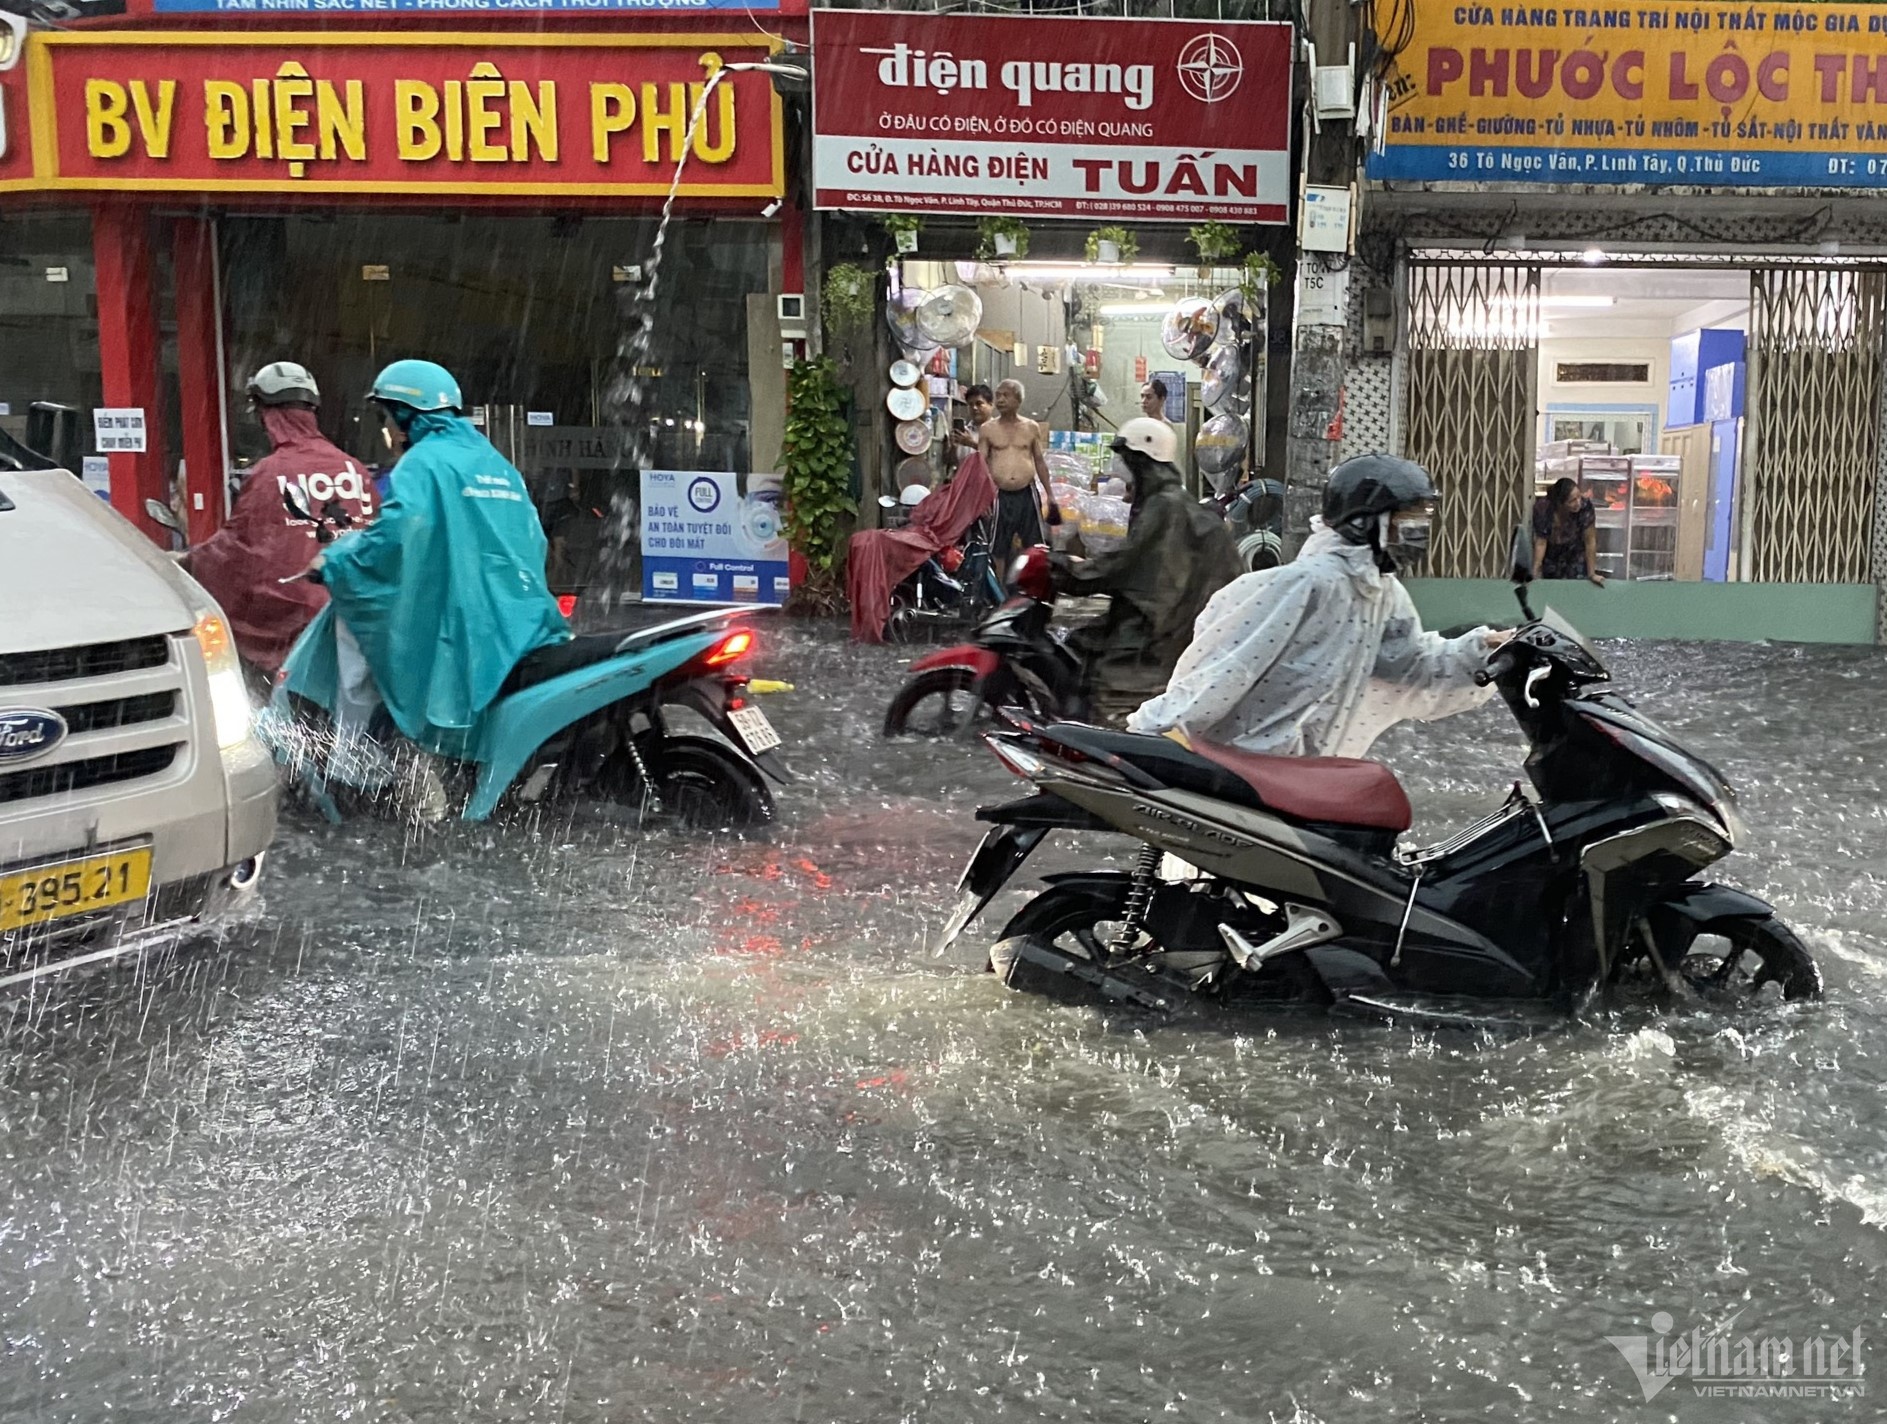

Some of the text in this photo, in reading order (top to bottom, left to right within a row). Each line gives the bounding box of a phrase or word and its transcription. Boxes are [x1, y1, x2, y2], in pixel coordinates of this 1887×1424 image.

[1454, 3, 1494, 26] CỬA
[1501, 5, 1558, 28] HÀNG
[1563, 9, 1631, 28] TRANG
[1637, 8, 1669, 29] TRÍ
[1675, 8, 1710, 34] NỘI
[1717, 6, 1767, 32] THẤT
[1773, 10, 1818, 35] MỘC
[1825, 14, 1860, 32] GIA
[860, 42, 1155, 110] điện quang
[1426, 36, 1645, 100] PHƯỚC
[1669, 39, 1790, 119] LỘC
[84, 79, 177, 159] BV
[204, 61, 367, 178] ĐIỆN
[395, 61, 558, 163] BIÊN
[590, 52, 736, 164] PHỦ
[894, 114, 927, 131] ĐÂU
[929, 115, 951, 132] CÓ
[954, 115, 992, 135] ĐIỆN,
[1009, 118, 1033, 134] ĐÓ
[1036, 118, 1057, 135] CÓ
[1060, 119, 1096, 138] ĐIỆN
[1098, 121, 1154, 138] QUANG
[1808, 116, 1850, 140] THẤT
[847, 143, 1259, 198] CỬA HÀNG ĐIỆN TUẤN
[1448, 152, 1469, 169] 36
[1476, 152, 1494, 169] Tô
[1501, 153, 1542, 174] Ngọc
[1549, 153, 1582, 172] Vân,
[1585, 154, 1598, 171] P.
[1602, 154, 1637, 171] Linh
[1643, 154, 1672, 173] Tây,
[1730, 154, 1760, 173] Đức
[1828, 158, 1856, 175] ĐT:
[695, 487, 713, 498] FULL
[648, 522, 660, 533] AN
[648, 537, 667, 548] CHO
[709, 563, 755, 572] Full Control
